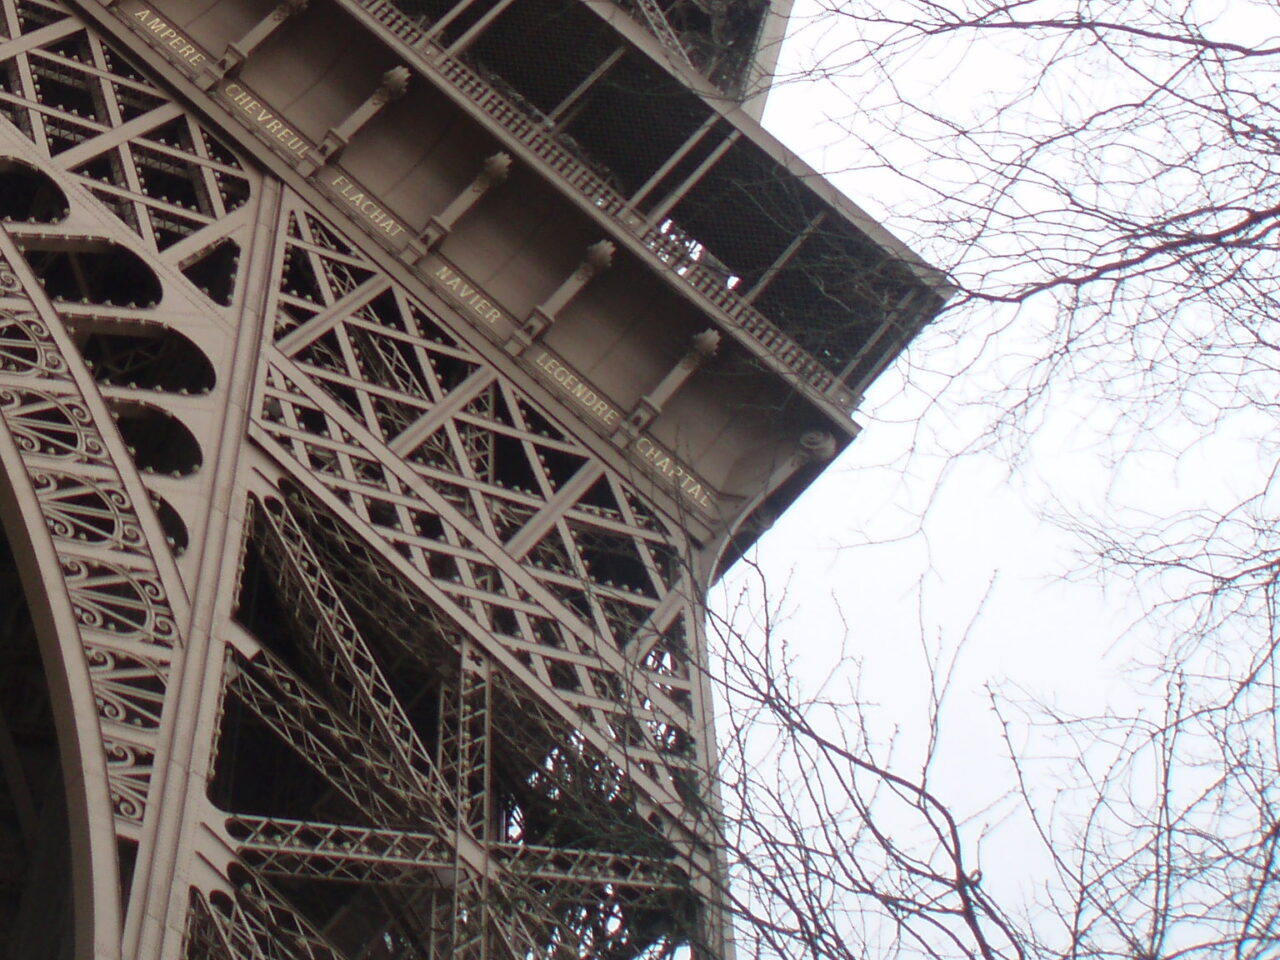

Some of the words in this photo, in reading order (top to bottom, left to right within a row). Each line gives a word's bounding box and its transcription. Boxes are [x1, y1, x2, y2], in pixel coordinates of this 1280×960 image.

[133, 7, 206, 68] AMPERE
[222, 81, 311, 161] CHEVREUL
[329, 174, 407, 239] FLACHAT
[433, 264, 502, 326] NAVIER
[534, 351, 619, 426] LEGENDRE
[633, 435, 708, 508] CHAPTAL
